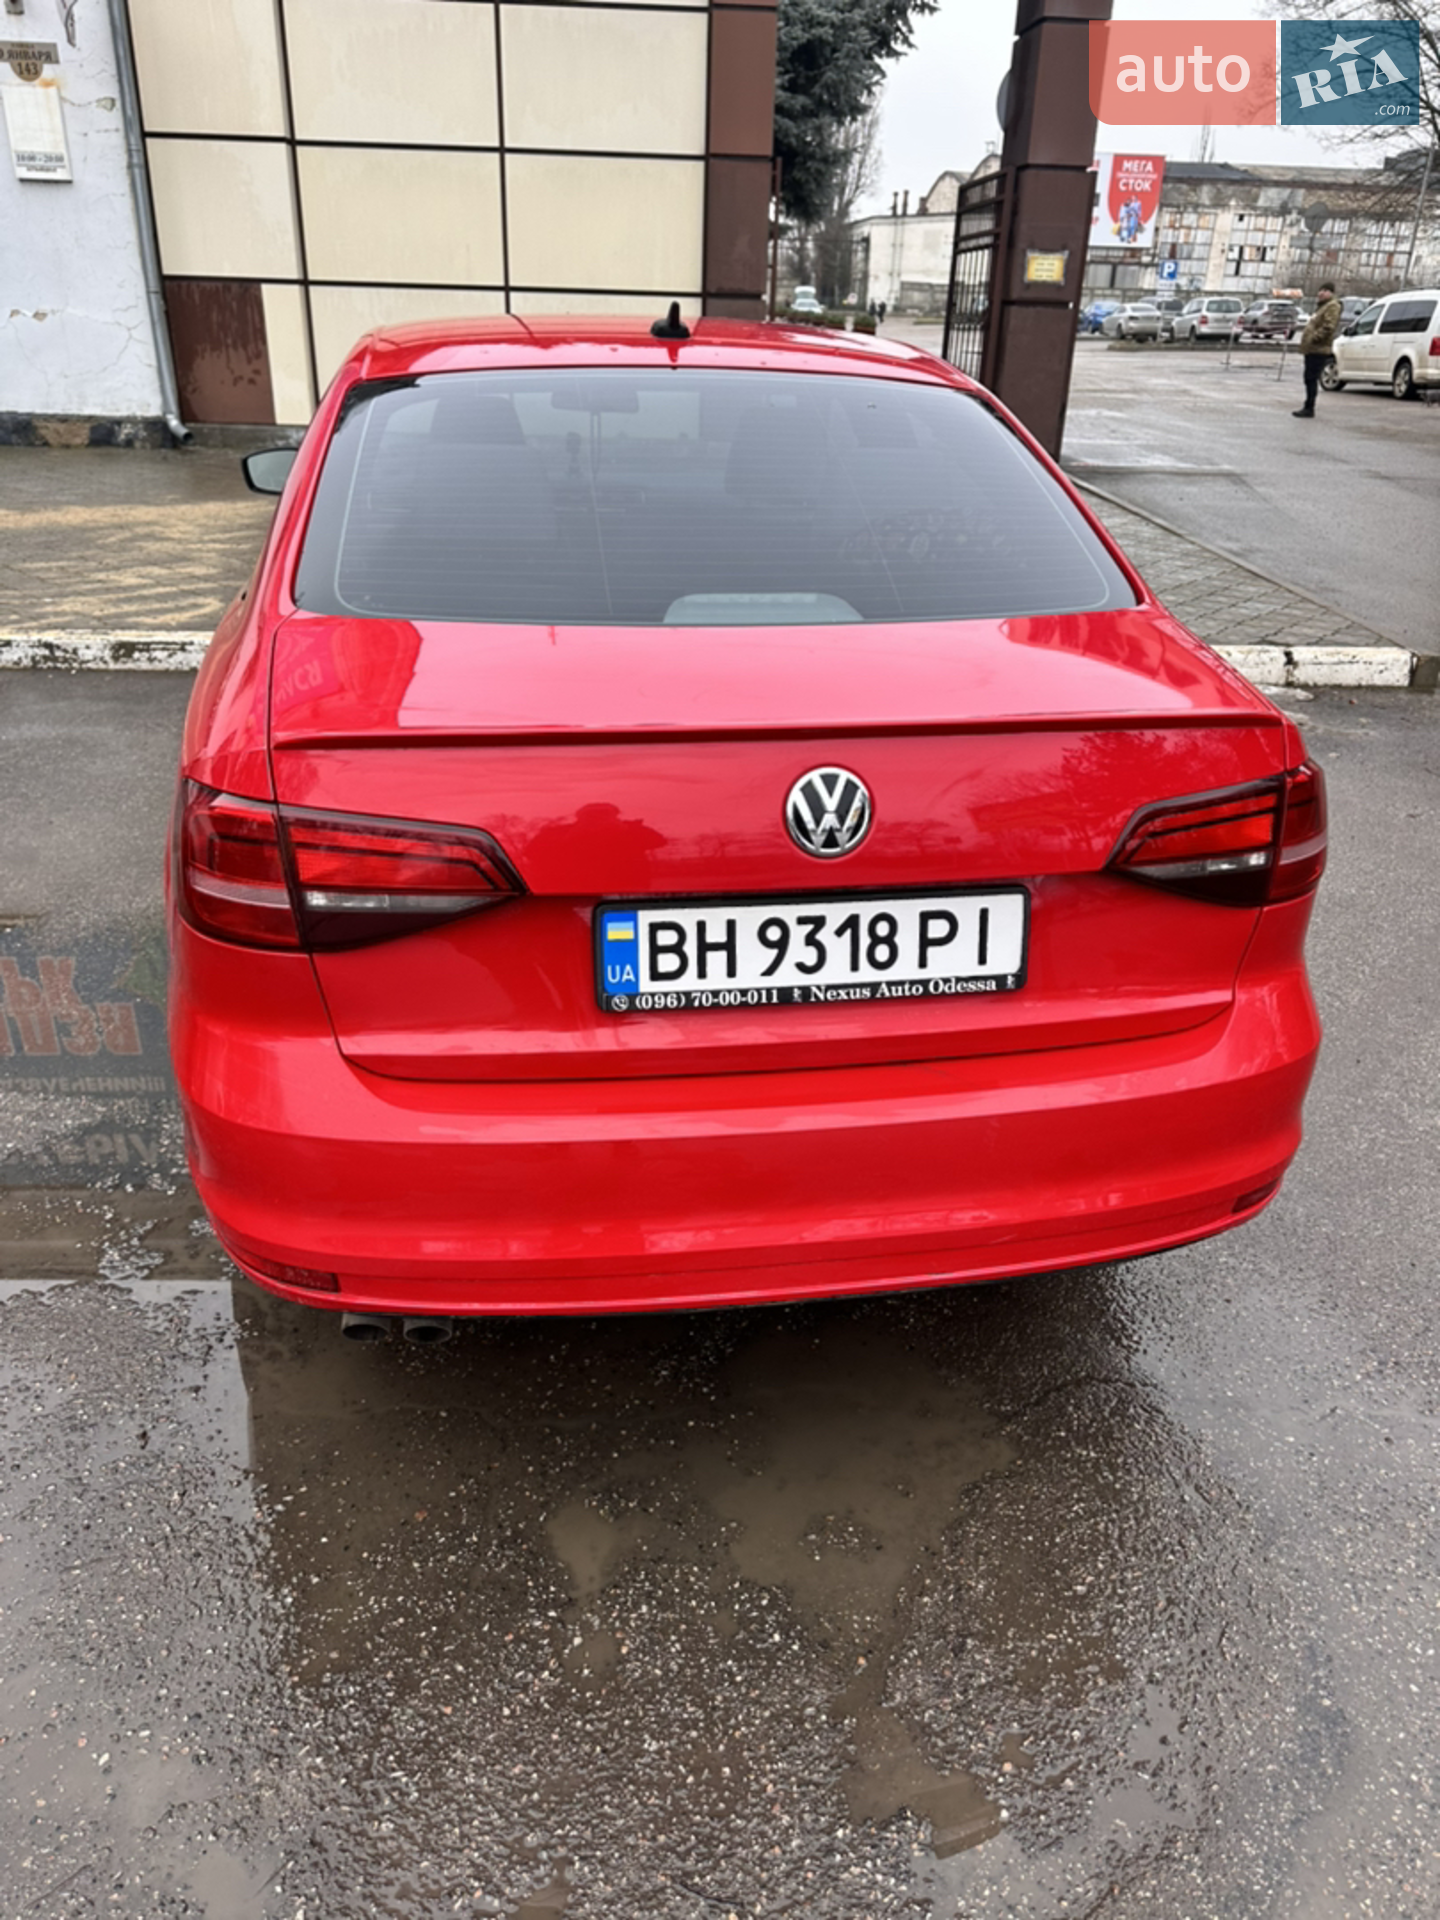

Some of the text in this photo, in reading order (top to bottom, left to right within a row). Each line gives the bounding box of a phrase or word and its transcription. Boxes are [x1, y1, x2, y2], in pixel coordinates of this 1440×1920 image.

[7, 49, 52, 62] ЯНВАРЯ
[17, 62, 39, 75] 143
[1123, 160, 1153, 172] МЕГА
[1119, 179, 1152, 191] СТОК
[1162, 262, 1175, 277] P
[648, 917, 738, 983] BH
[756, 911, 899, 978] 9318
[607, 964, 636, 983] UA
[635, 975, 998, 1010] (096) 70-00-011 Nexus Auto Odessa
